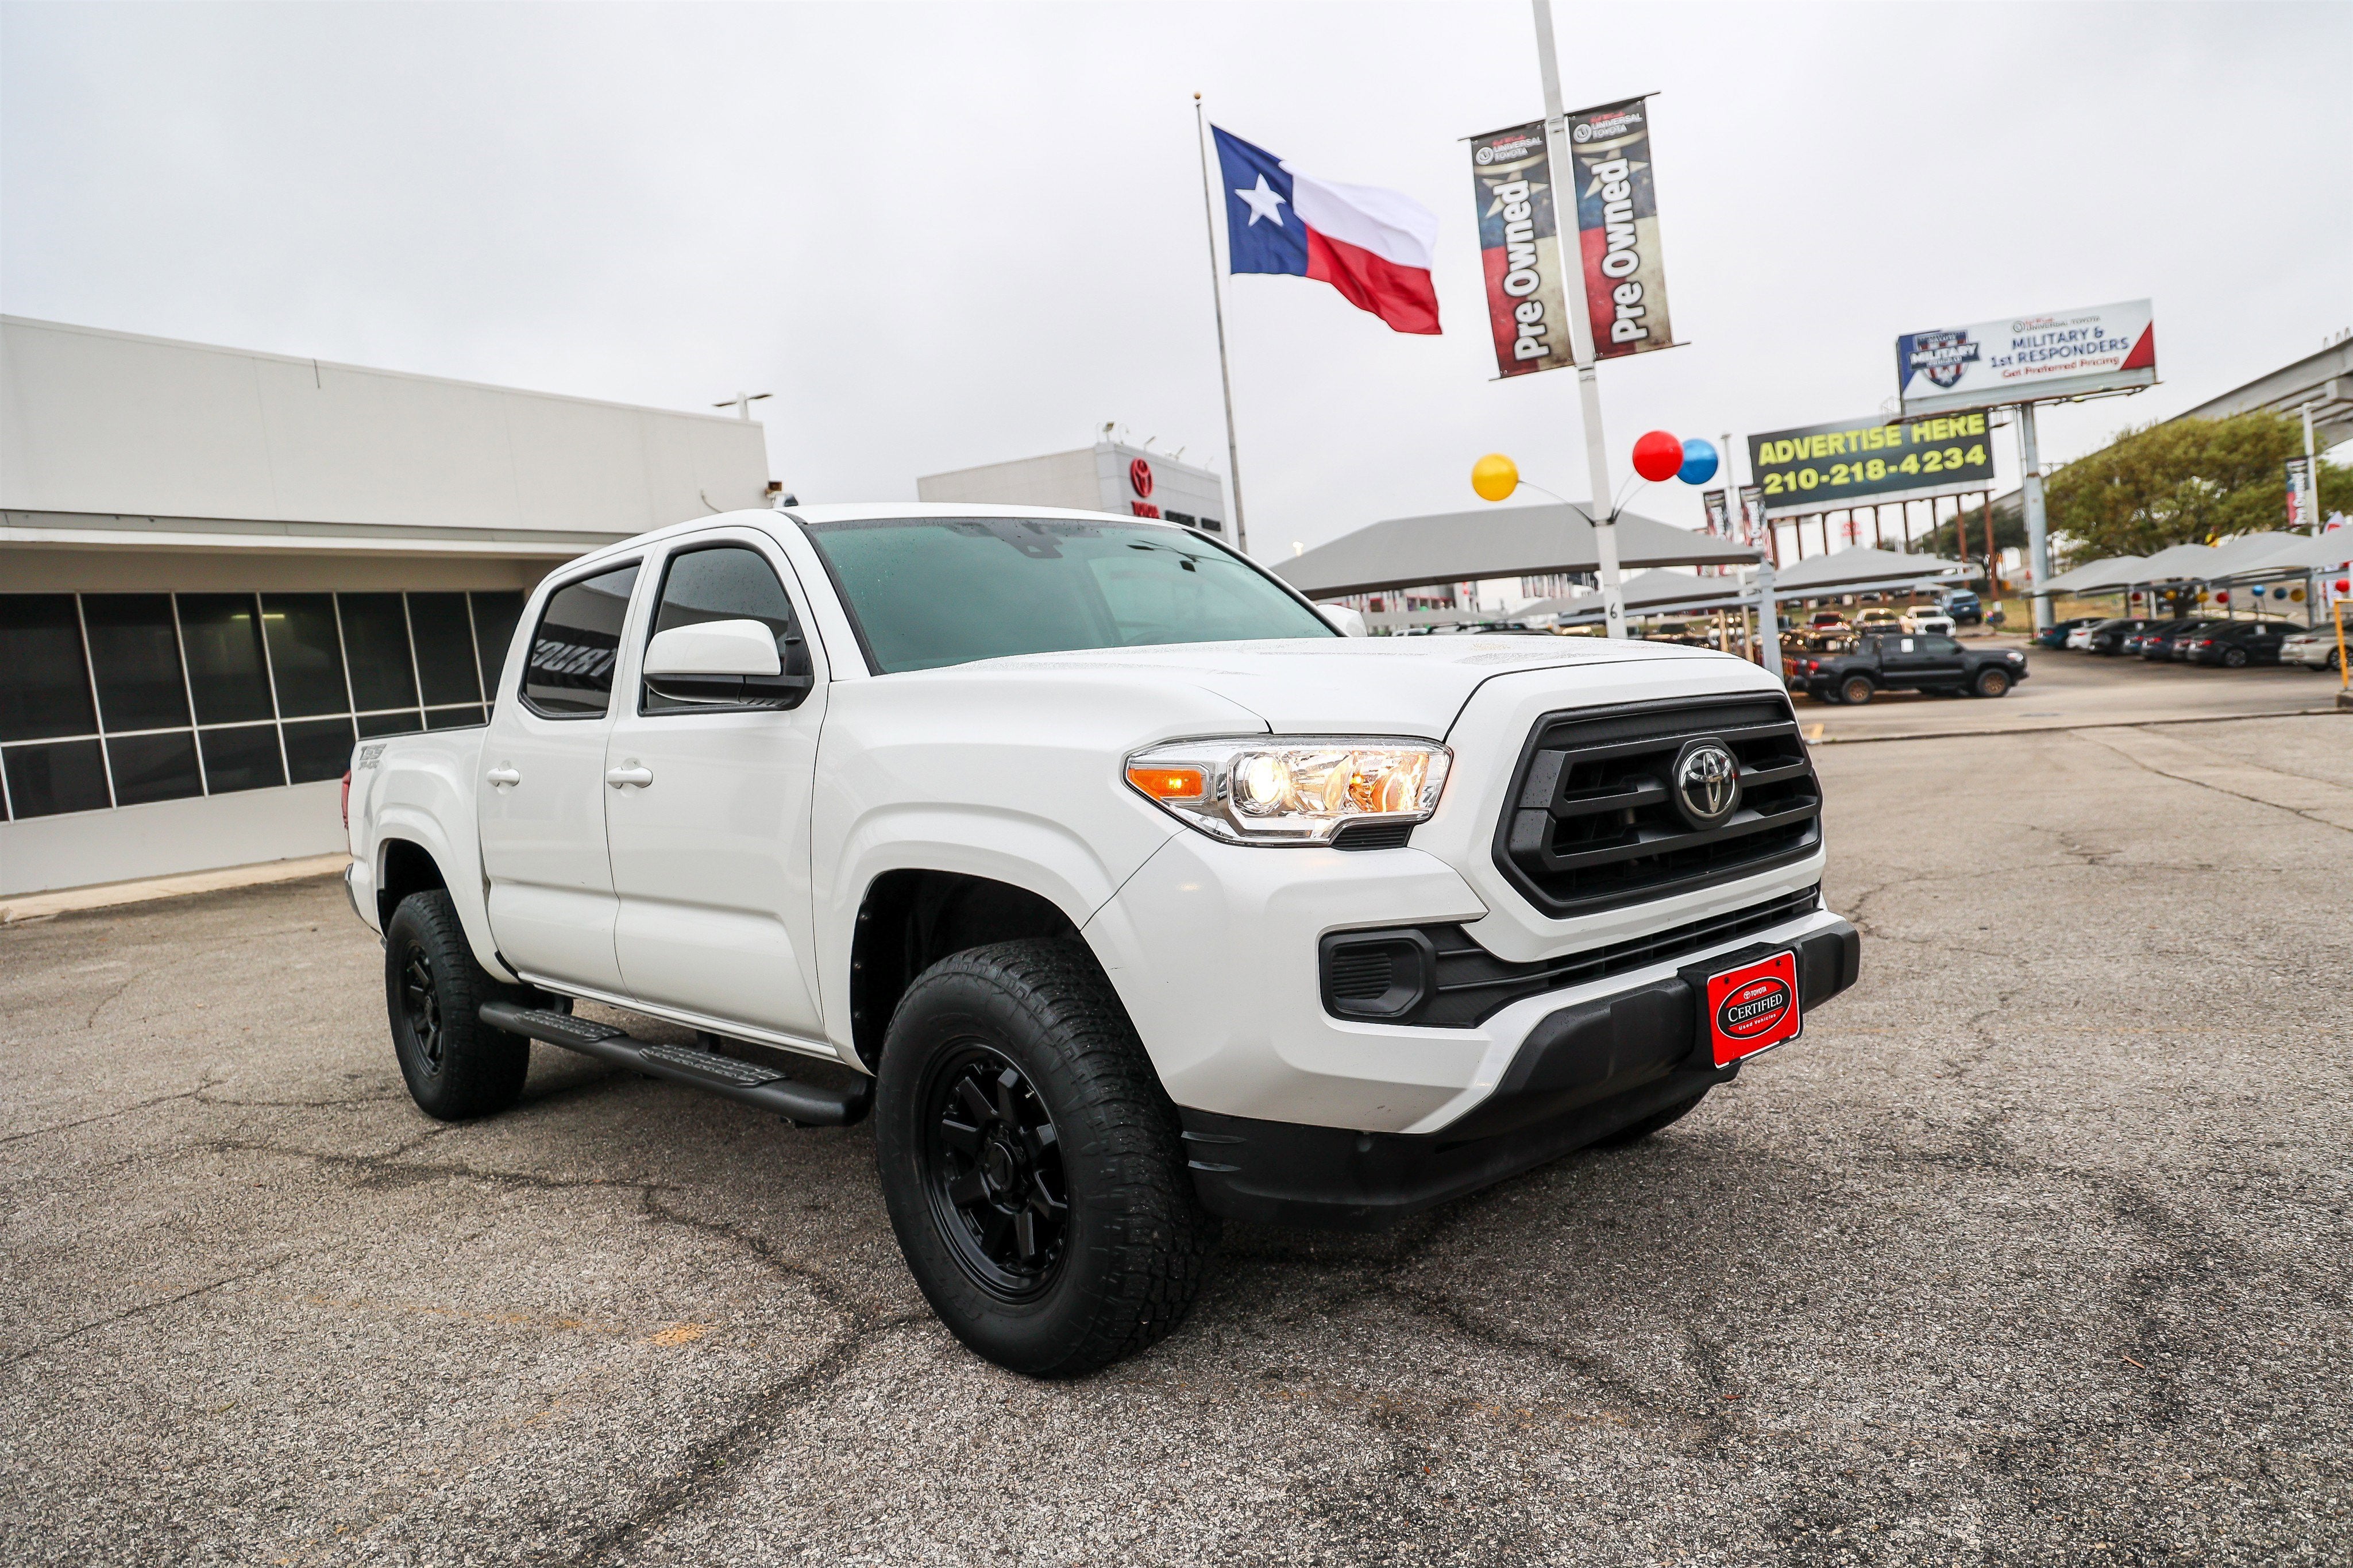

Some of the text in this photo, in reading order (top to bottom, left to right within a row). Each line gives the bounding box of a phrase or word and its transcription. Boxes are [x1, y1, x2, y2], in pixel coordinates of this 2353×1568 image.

[1591, 113, 1643, 130] UNIVERSAL
[1592, 125, 1627, 139] TOYOTA
[1494, 136, 1542, 153] UNIVERSAL
[1494, 148, 1529, 163] TOYOTA
[1592, 158, 1640, 279] Owned
[1494, 180, 1540, 296] Owned
[1611, 282, 1648, 343] Pre
[1514, 300, 1550, 361] Pre
[2012, 326, 2104, 350] MILITARY &
[1991, 335, 2130, 368] 1st RESPONDERS
[2002, 356, 2120, 379] Get Preferred Pricing
[1758, 413, 1986, 466] ADVERTISE HERE
[1763, 444, 1987, 495] 210-218-4234
[1610, 602, 1618, 619] 6
[1750, 986, 1767, 997] TOYOTA
[1728, 994, 1783, 1022] CERTIFIED
[1738, 1013, 1777, 1031] Used Vehicles
